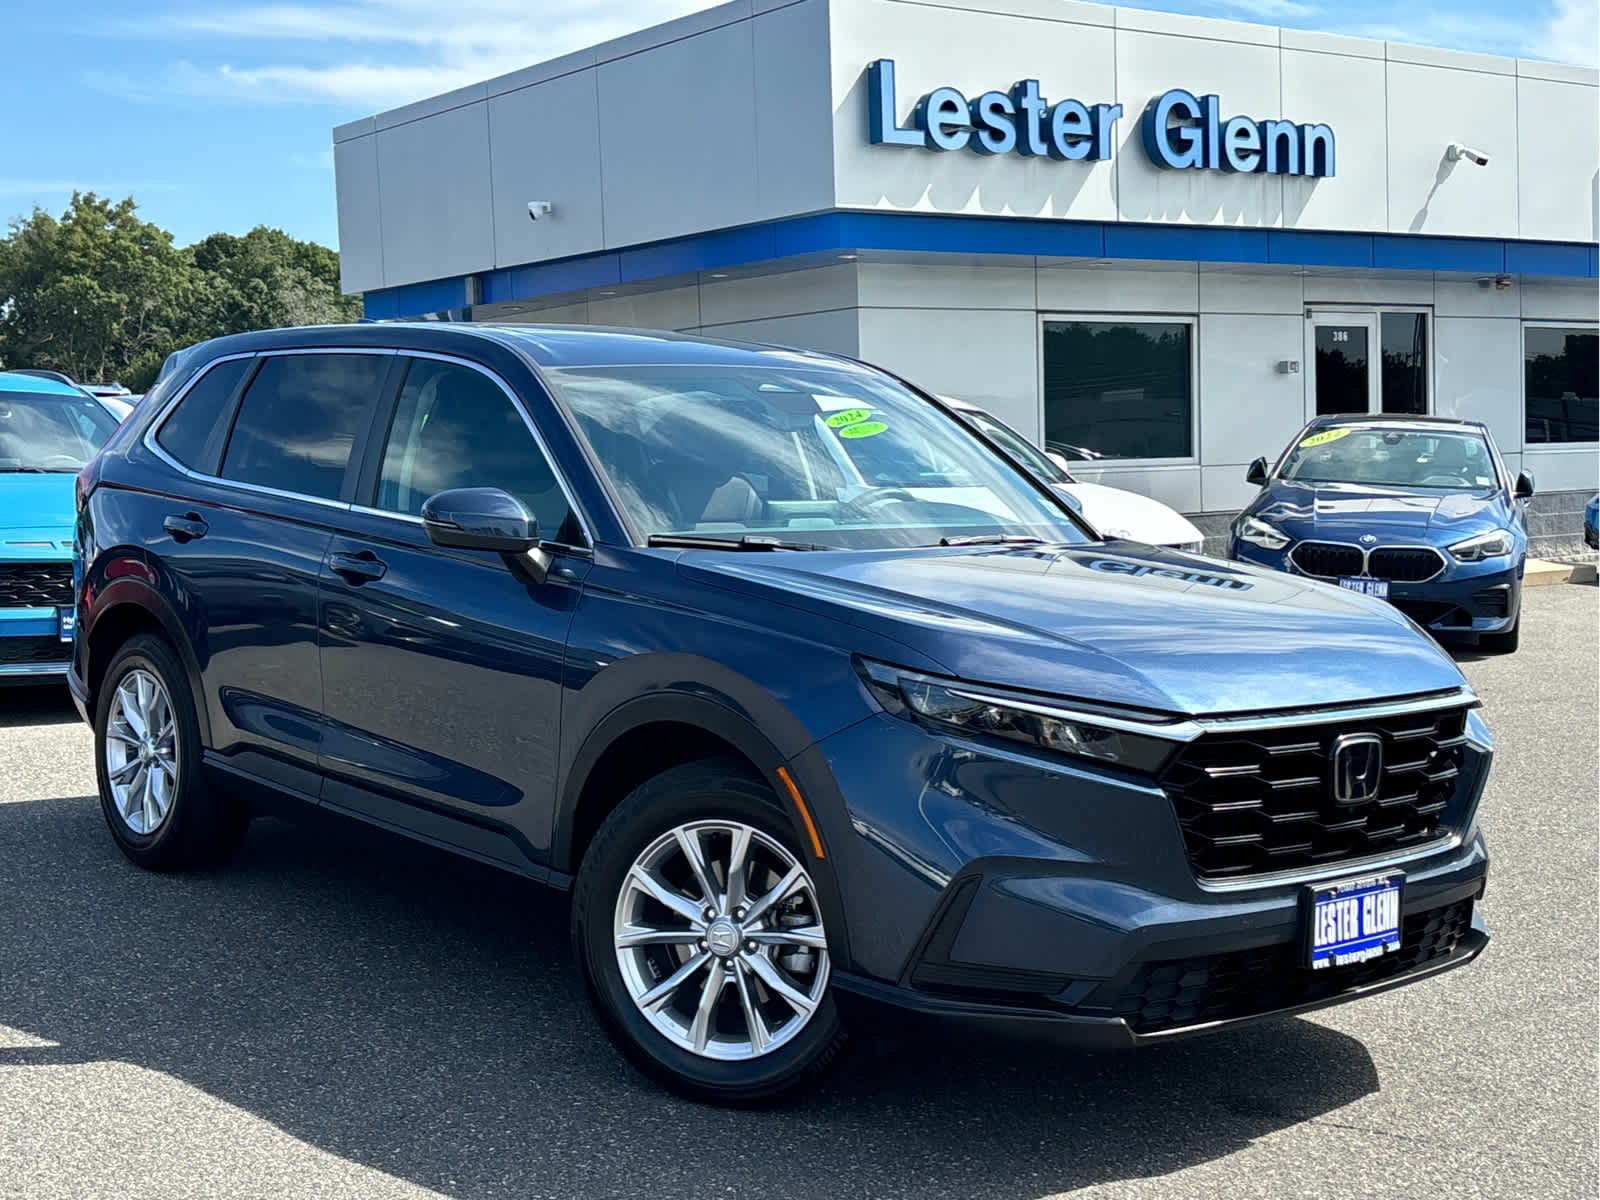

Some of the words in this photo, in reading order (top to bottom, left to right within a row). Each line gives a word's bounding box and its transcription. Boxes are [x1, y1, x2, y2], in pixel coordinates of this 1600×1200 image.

[868, 58, 1122, 162] Lester
[1143, 88, 1336, 177] Glenn
[1314, 898, 1359, 947] LESTER
[1362, 889, 1399, 936] GLENN
